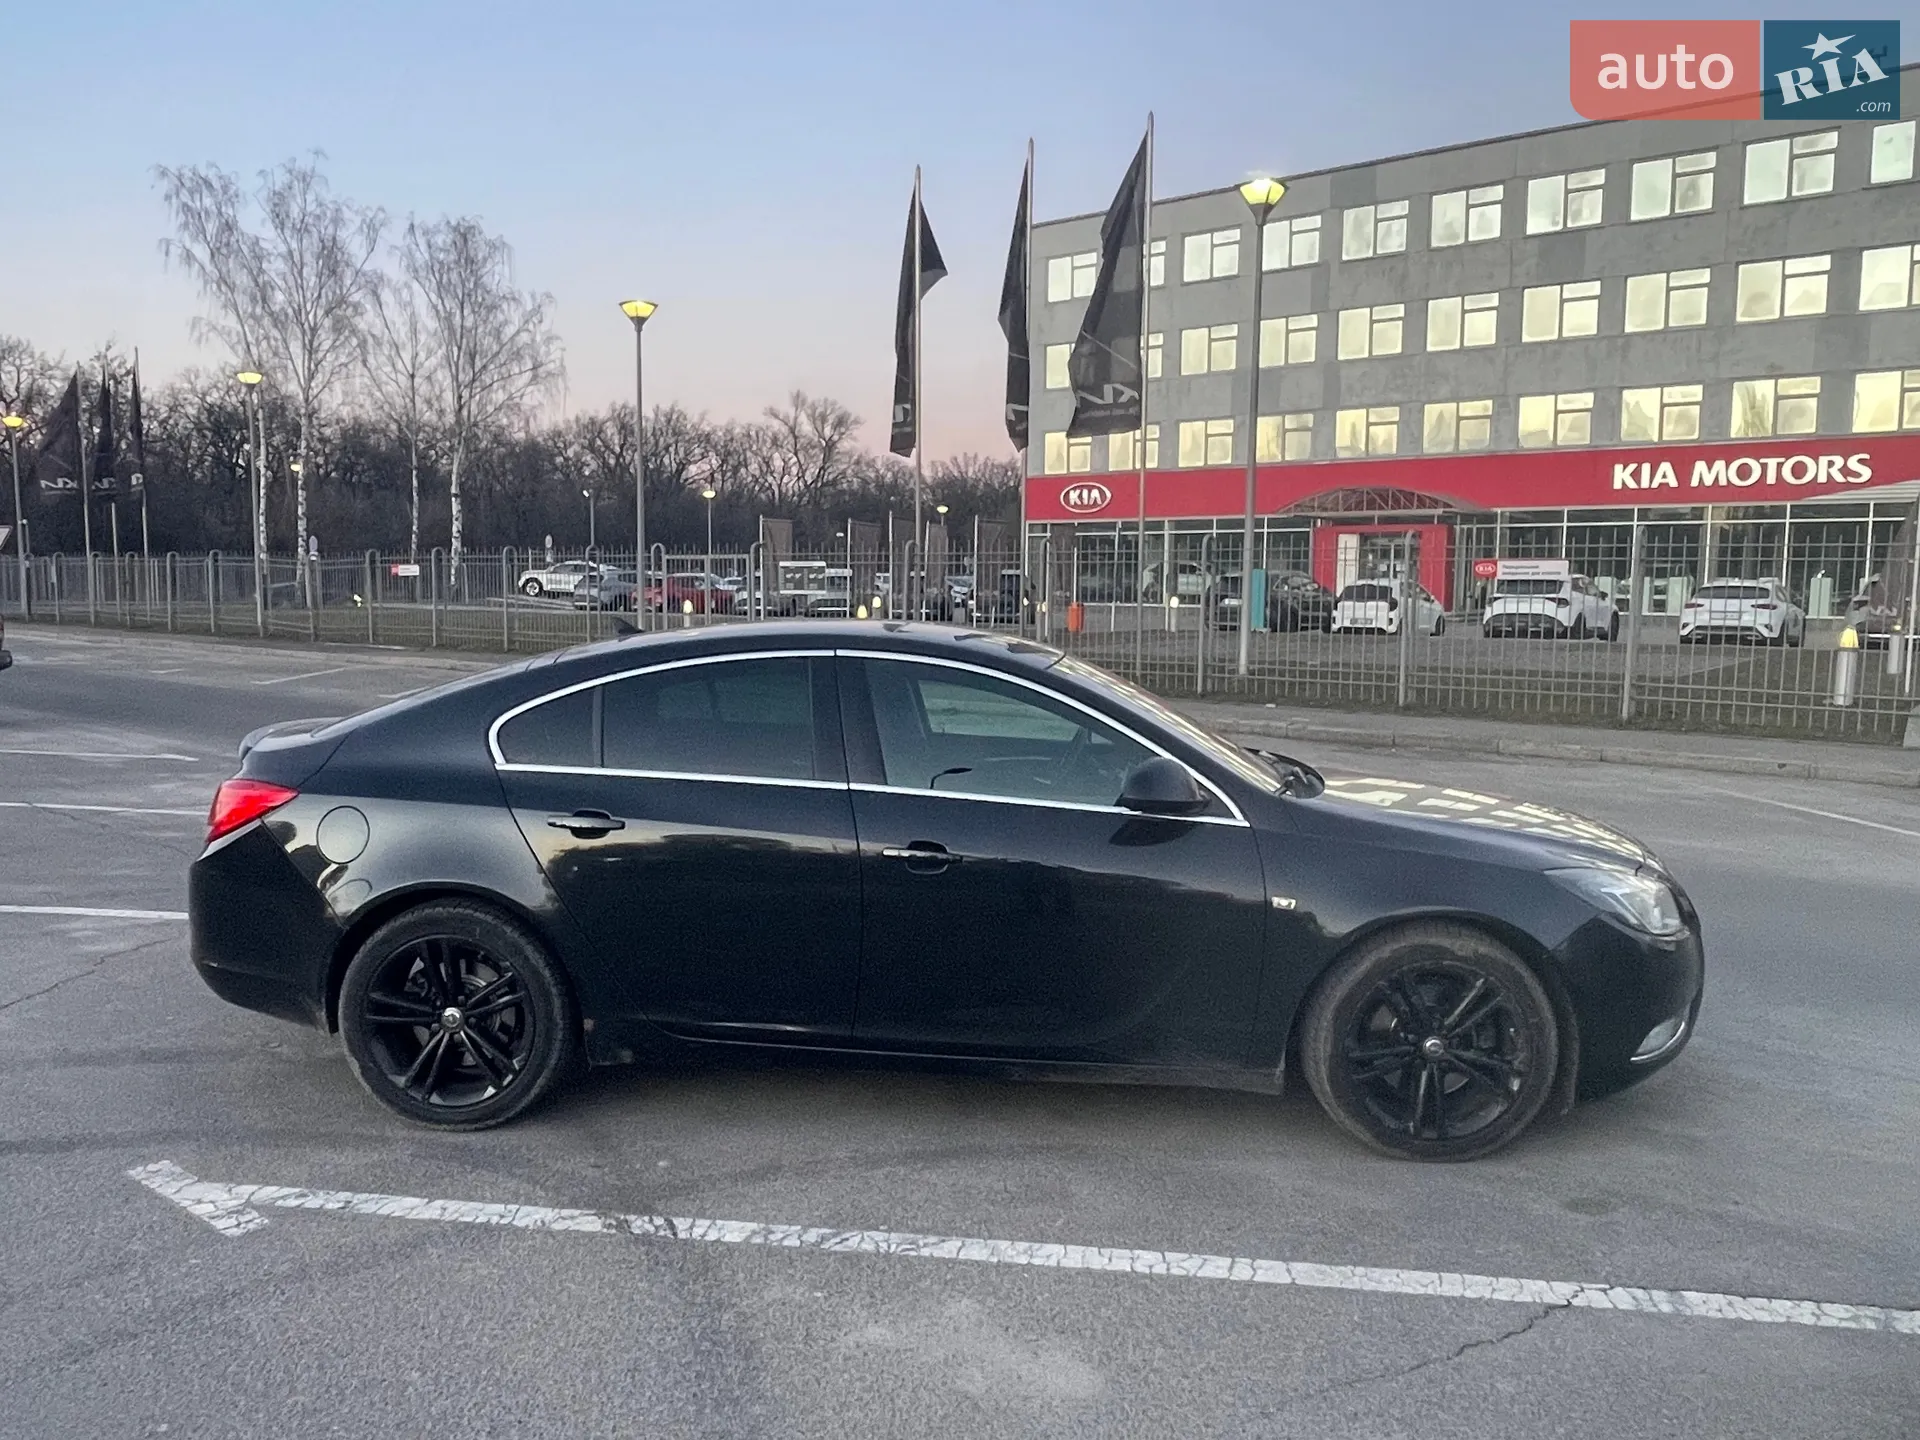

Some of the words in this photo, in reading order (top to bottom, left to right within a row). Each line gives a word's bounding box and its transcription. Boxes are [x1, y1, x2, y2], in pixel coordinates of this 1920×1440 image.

[1613, 461, 1679, 490] KIA
[1690, 453, 1873, 487] MOTORS
[1069, 488, 1102, 506] KIA
